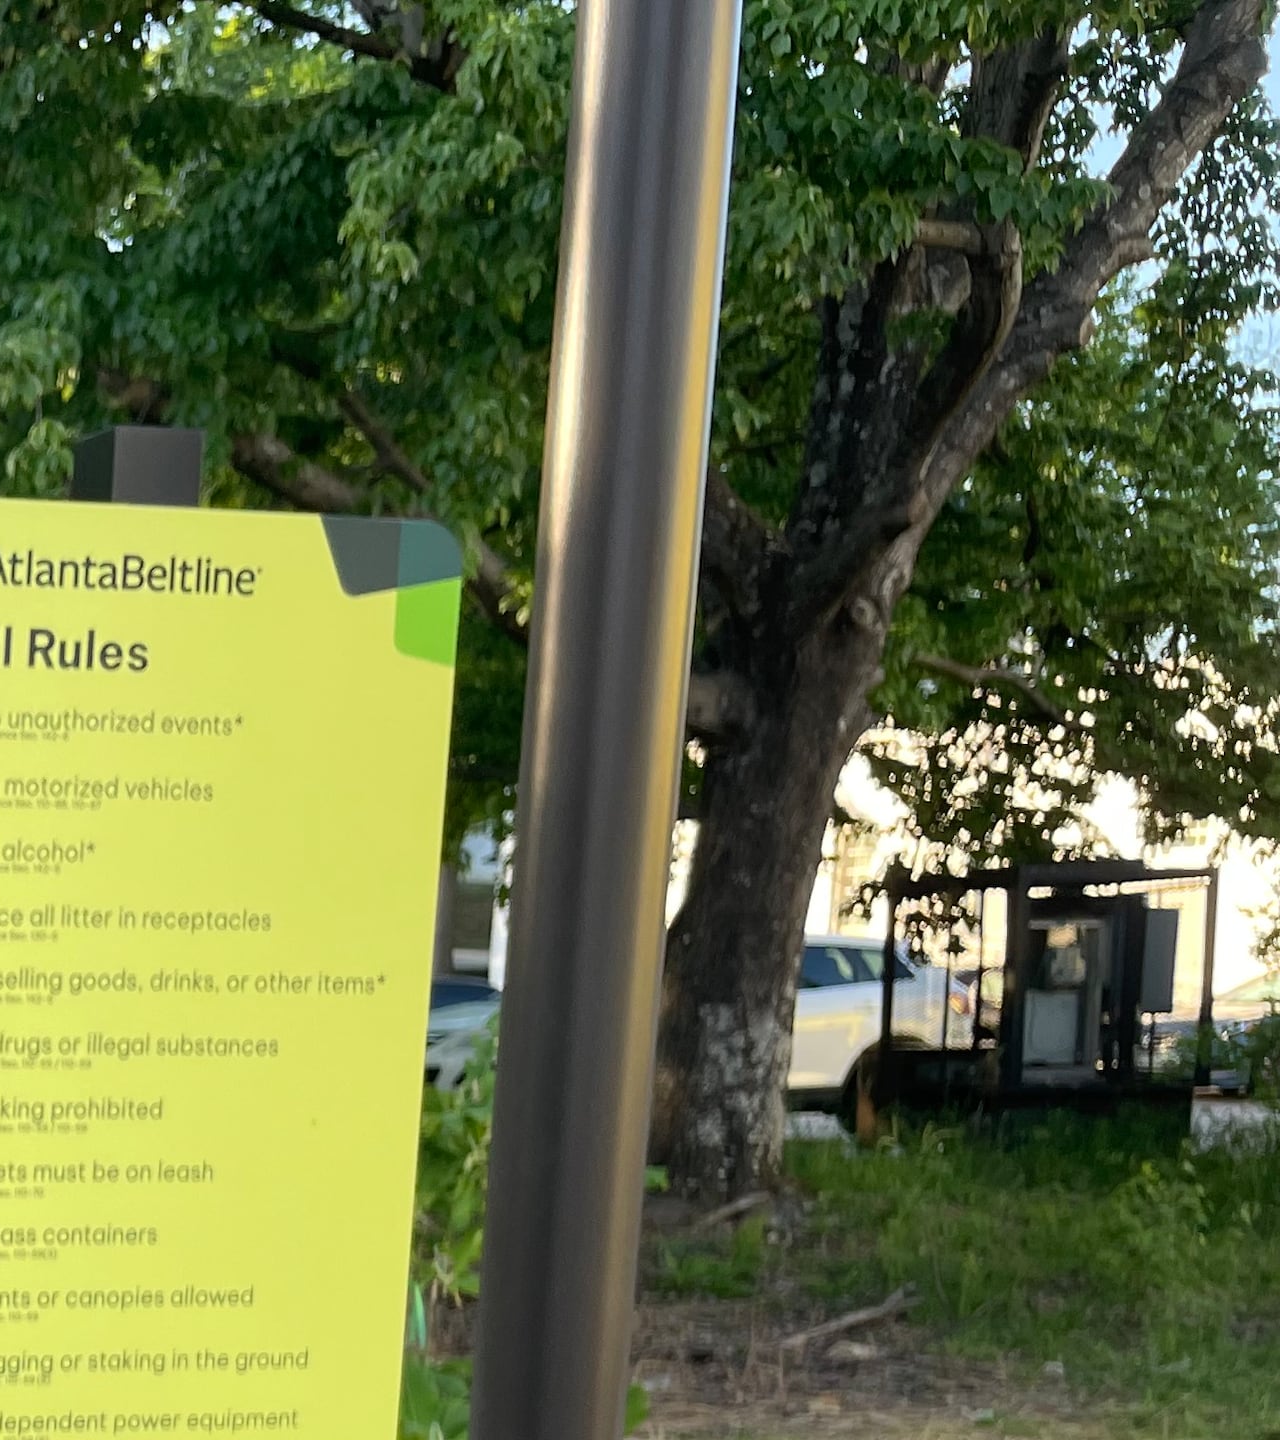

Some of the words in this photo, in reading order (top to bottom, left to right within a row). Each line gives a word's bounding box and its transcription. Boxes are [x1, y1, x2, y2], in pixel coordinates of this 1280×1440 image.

[27, 628, 149, 673] Rules
[7, 709, 154, 734] unauthorized
[4, 775, 118, 800] motorized
[125, 777, 214, 802] vehicles
[29, 904, 54, 928] all
[61, 904, 113, 929] litter
[119, 906, 136, 928] in
[142, 906, 271, 934] receptacles
[69, 970, 142, 997] goods,
[150, 971, 220, 996] drinks,
[226, 977, 248, 994] or
[255, 974, 311, 995] other
[58, 1038, 82, 1055] or
[87, 1033, 151, 1061] illegal
[156, 1035, 279, 1058] substances
[51, 1098, 163, 1126] prohibited
[33, 1164, 87, 1184] must
[93, 1160, 119, 1184] be
[125, 1166, 152, 1184] on
[158, 1160, 213, 1184] leash
[42, 1224, 158, 1247] containers
[37, 1291, 60, 1308] or
[65, 1286, 165, 1313] canopies
[170, 1285, 254, 1308] allowed
[60, 1355, 83, 1372] or
[88, 1349, 166, 1375] staking
[171, 1349, 189, 1370] in
[196, 1348, 229, 1370] the
[235, 1347, 309, 1374] ground
[113, 1414, 180, 1436] power
[186, 1408, 299, 1435] equipment
